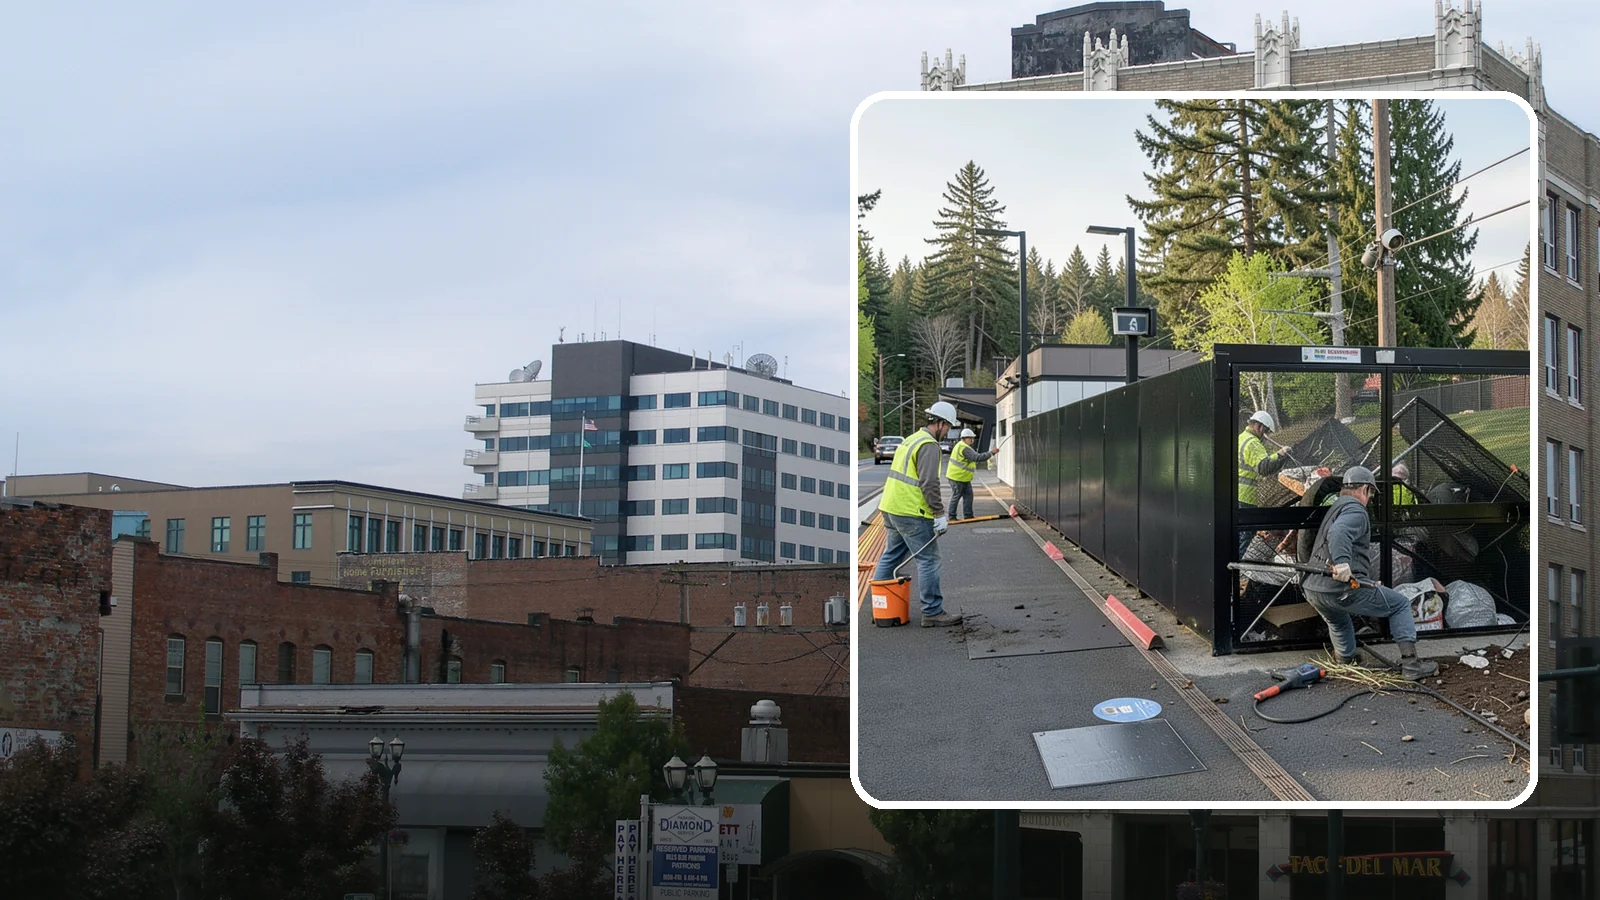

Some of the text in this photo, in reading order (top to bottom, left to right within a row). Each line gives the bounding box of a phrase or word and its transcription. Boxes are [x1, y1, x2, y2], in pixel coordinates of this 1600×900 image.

[343, 564, 427, 577] Home Furnishers
[660, 818, 713, 833] DIAMOND
[1021, 815, 1070, 827] BUILDING
[617, 825, 625, 853] PAY
[629, 825, 637, 853] PAY
[689, 846, 716, 854] PARKING
[721, 851, 739, 862] Soup
[671, 862, 701, 870] PATRONS
[1346, 856, 1385, 875] DEL
[1392, 857, 1442, 876] MAR
[616, 856, 625, 894] HERE
[628, 856, 637, 893] HERE
[660, 888, 710, 898] PUBLIC PARKING
